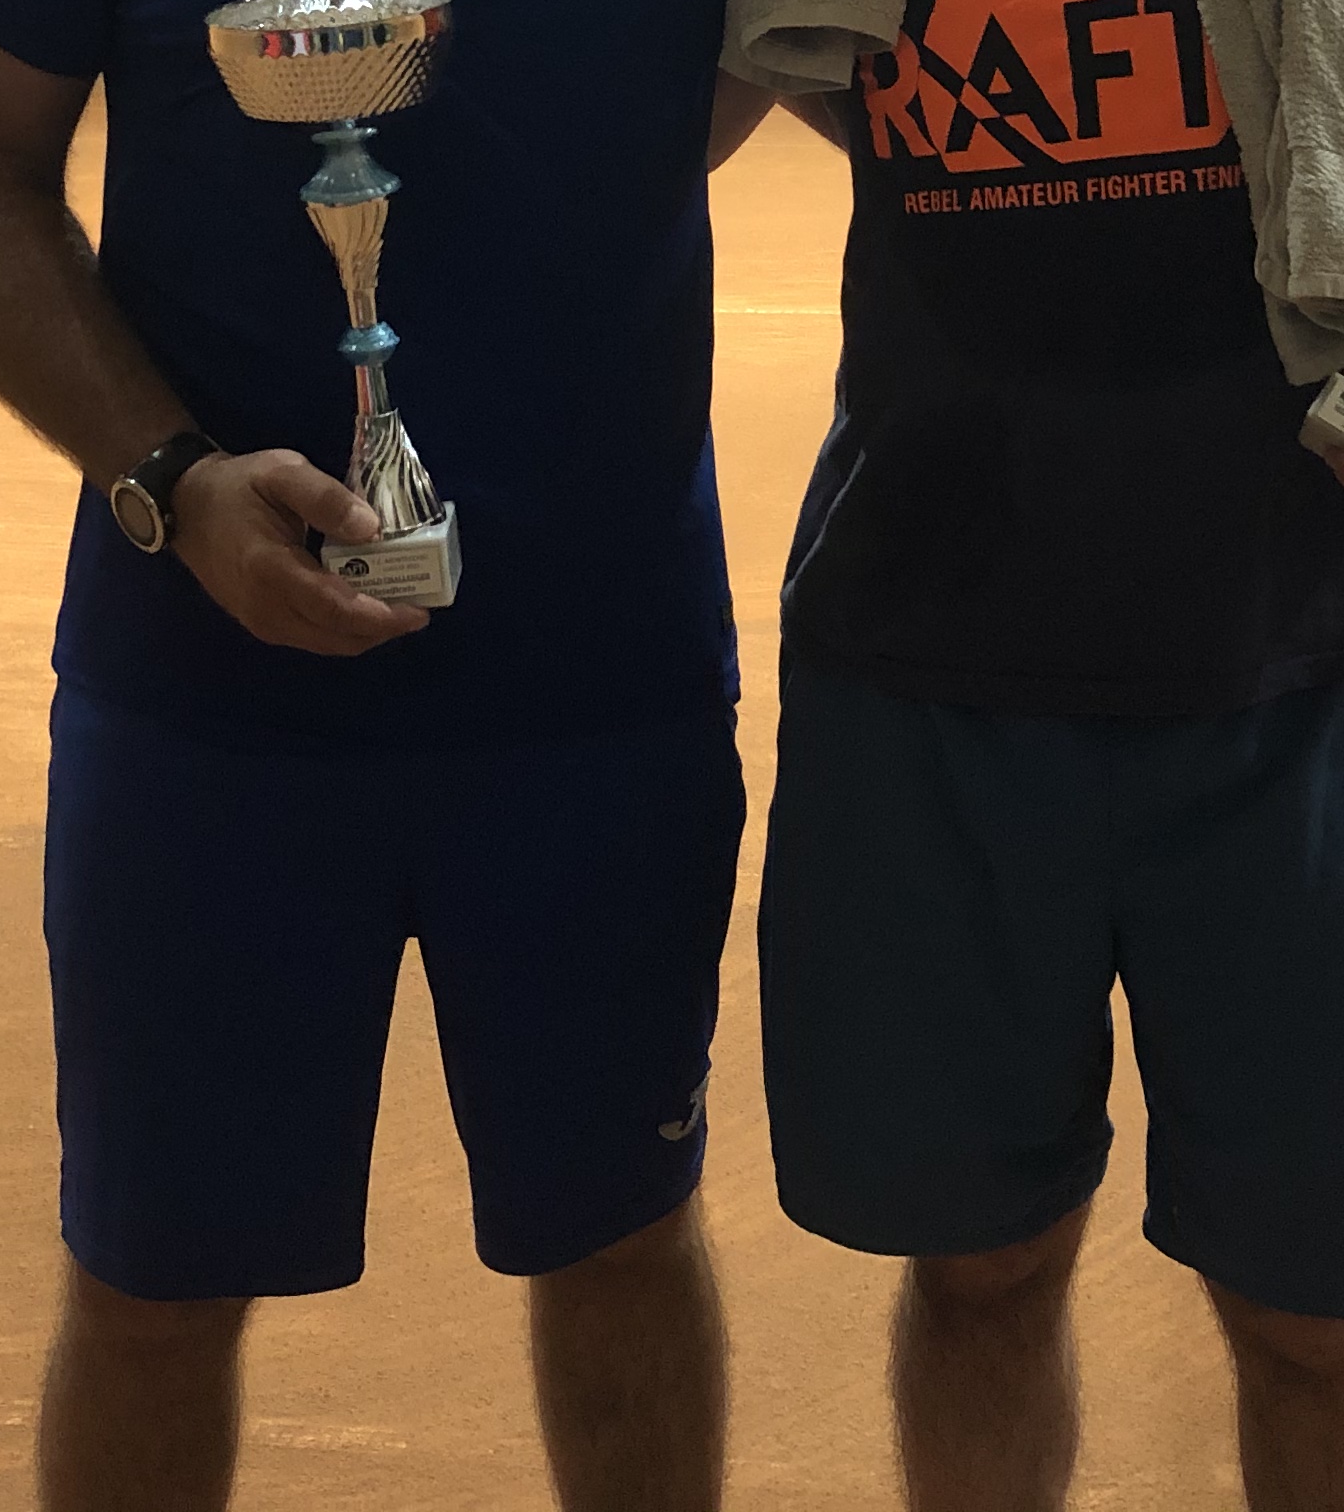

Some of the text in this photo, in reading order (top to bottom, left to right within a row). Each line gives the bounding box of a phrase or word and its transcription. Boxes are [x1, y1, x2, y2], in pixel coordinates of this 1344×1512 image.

[904, 190, 962, 215] REBEL
[969, 179, 1080, 212] AMATEUR
[1086, 170, 1187, 201] FIGHTER
